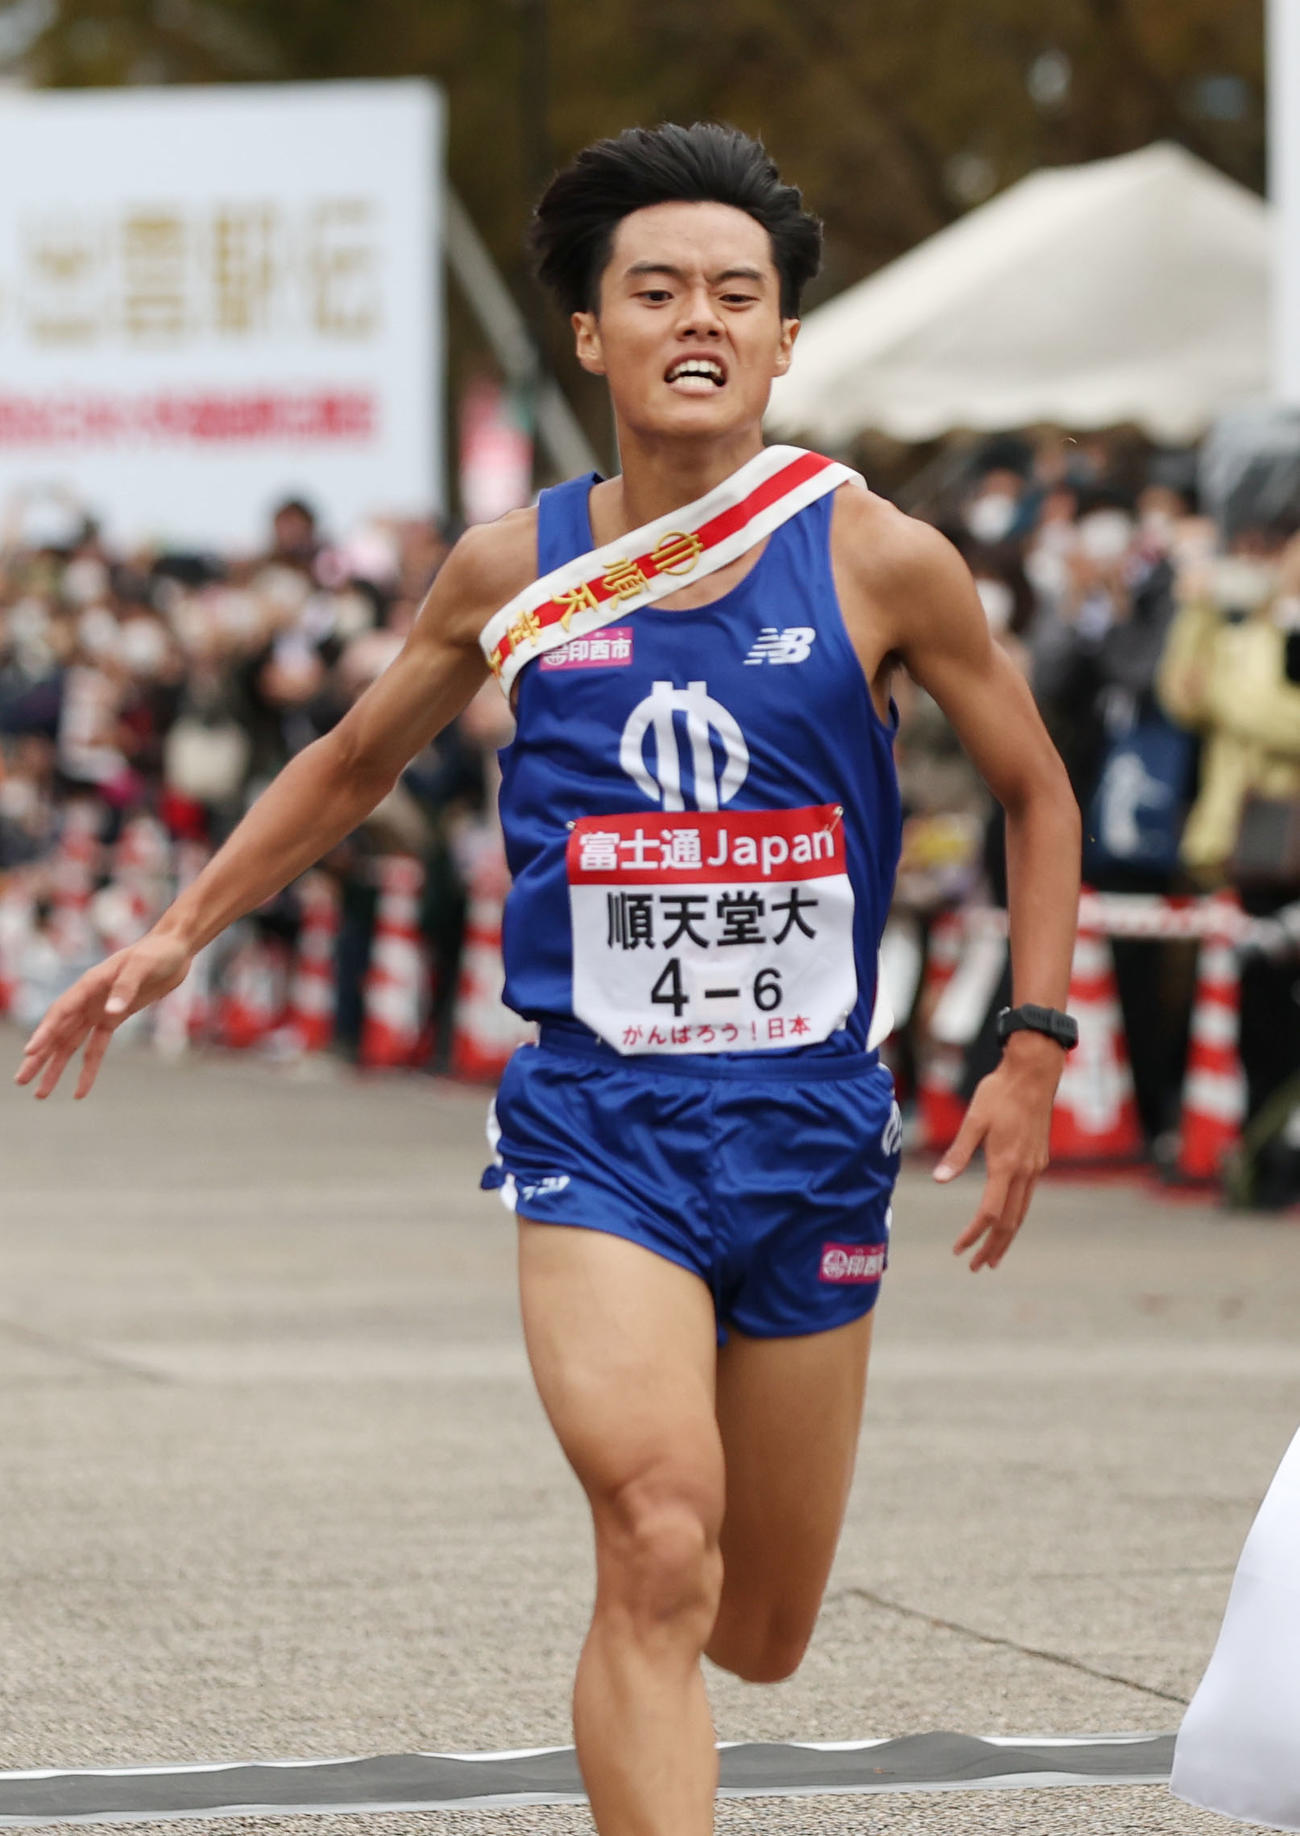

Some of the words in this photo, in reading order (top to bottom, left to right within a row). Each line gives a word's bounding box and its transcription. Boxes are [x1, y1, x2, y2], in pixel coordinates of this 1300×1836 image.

[568, 638, 632, 662] 印西市
[606, 887, 819, 950] 順天堂大
